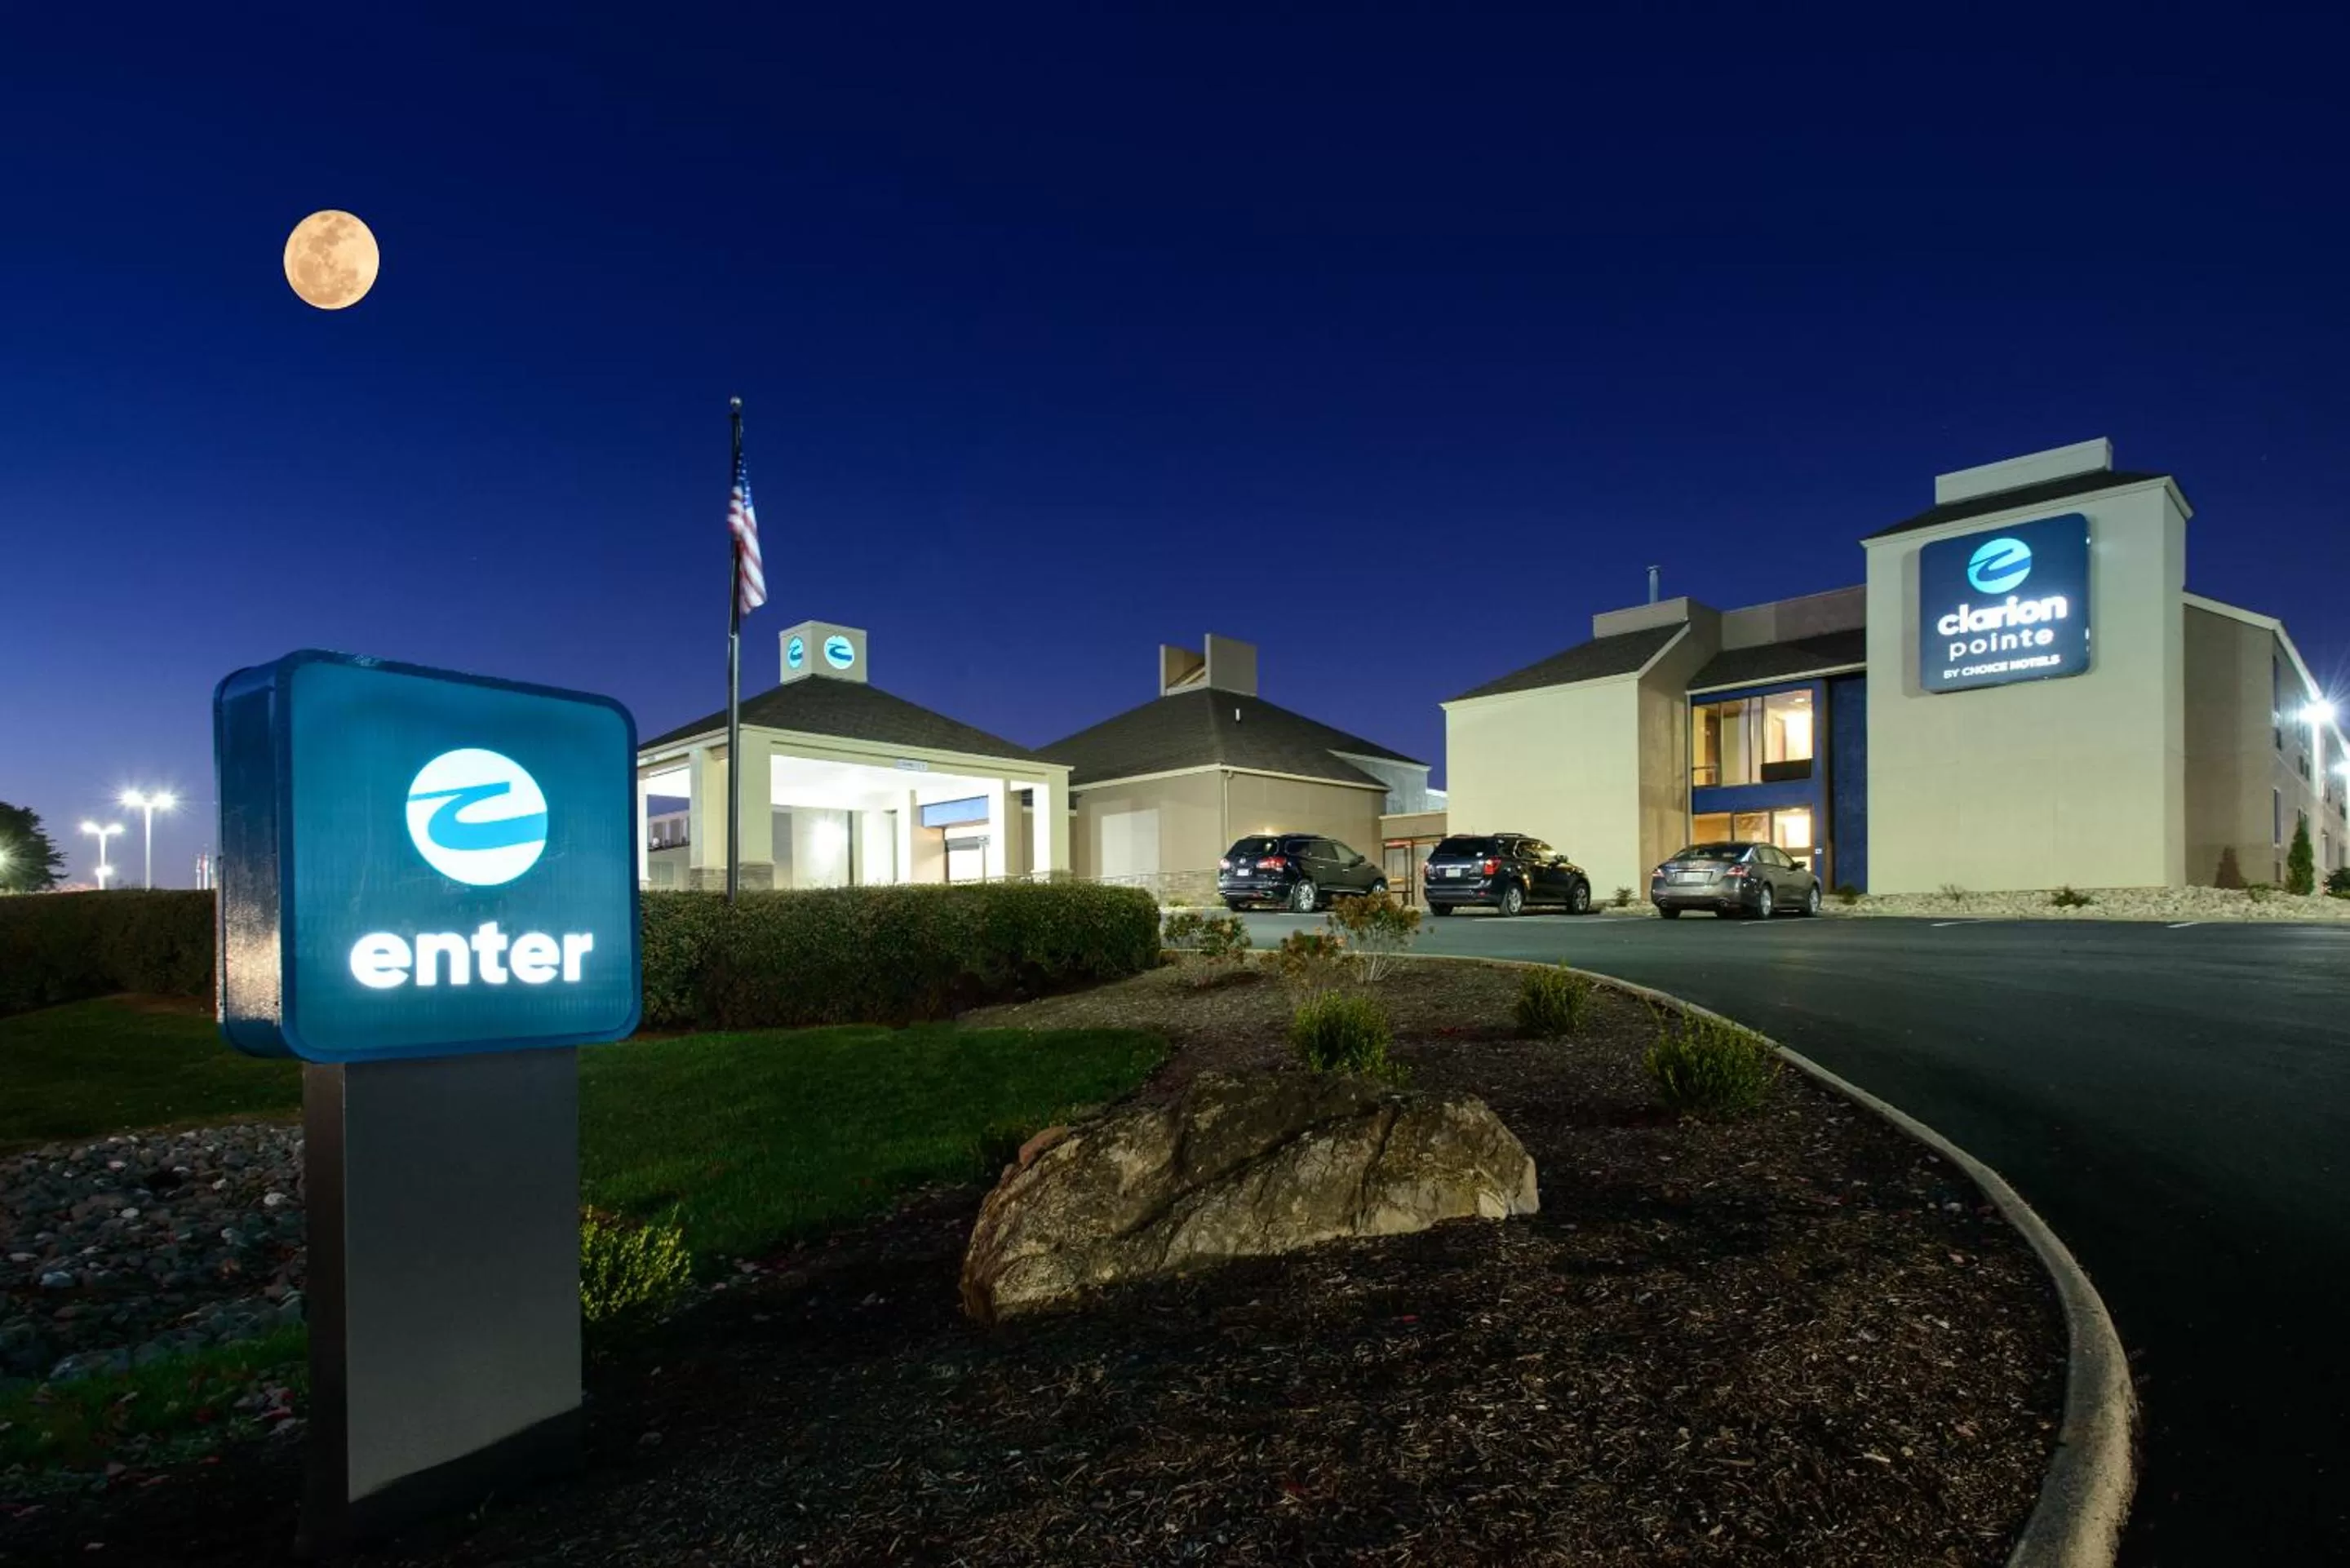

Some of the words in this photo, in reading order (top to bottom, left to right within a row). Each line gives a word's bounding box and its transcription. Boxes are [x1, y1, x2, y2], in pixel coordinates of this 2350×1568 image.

[1937, 596, 2068, 636] clarion
[1949, 627, 2055, 662] pointe
[1943, 667, 1960, 679] BY
[1962, 660, 2008, 676] CHOICE
[2010, 653, 2061, 670] HOTELS
[349, 921, 594, 990] enter
